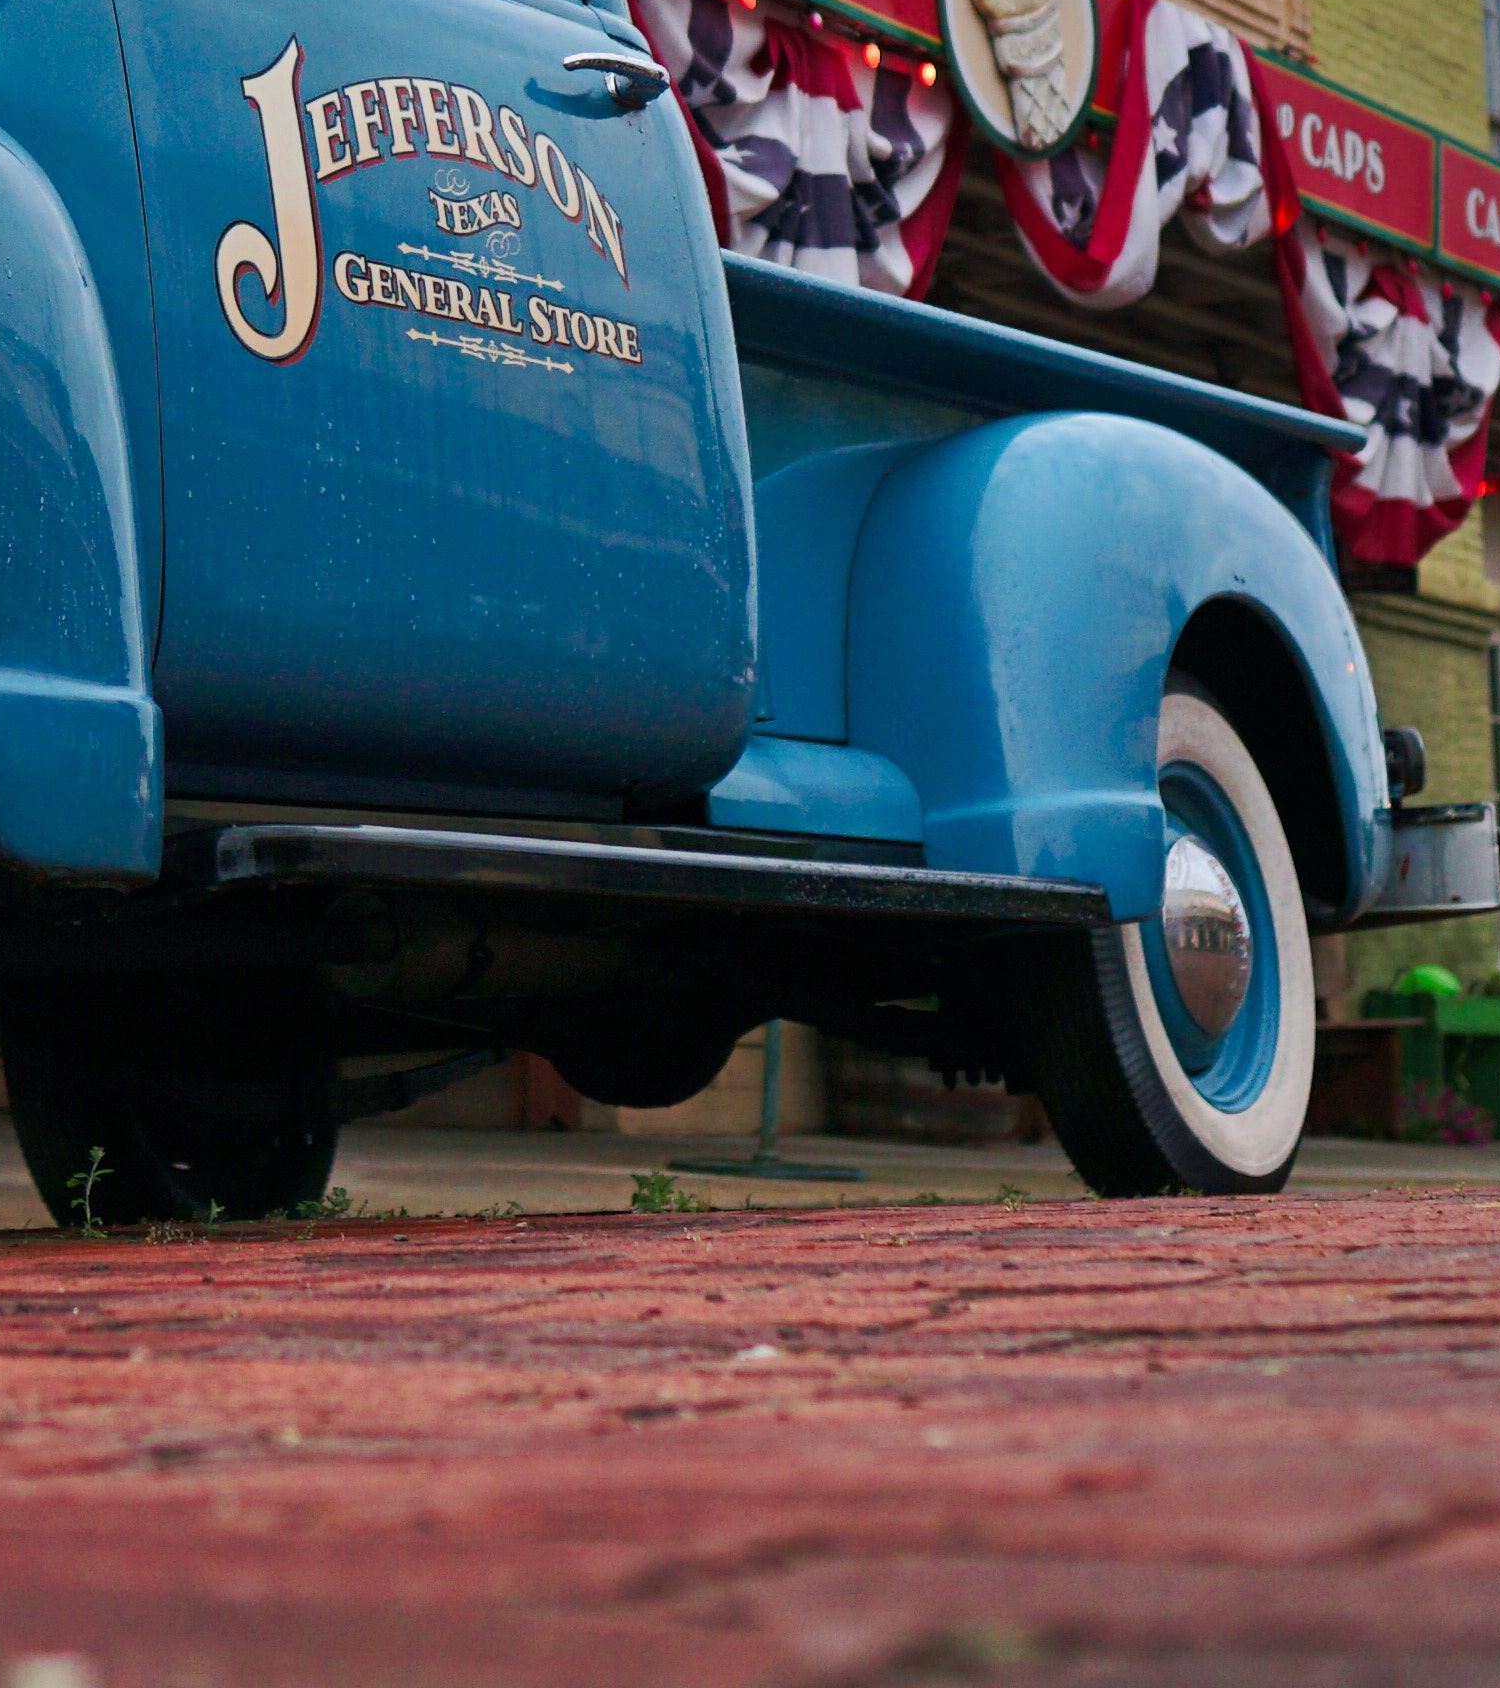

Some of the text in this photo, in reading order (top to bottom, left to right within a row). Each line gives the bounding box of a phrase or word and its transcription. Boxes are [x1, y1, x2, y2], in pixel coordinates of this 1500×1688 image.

[214, 32, 632, 366] JEFFERSON
[1300, 111, 1386, 195] CAPS
[427, 186, 522, 236] TEXAS
[333, 250, 644, 366] GENERAL STORE
